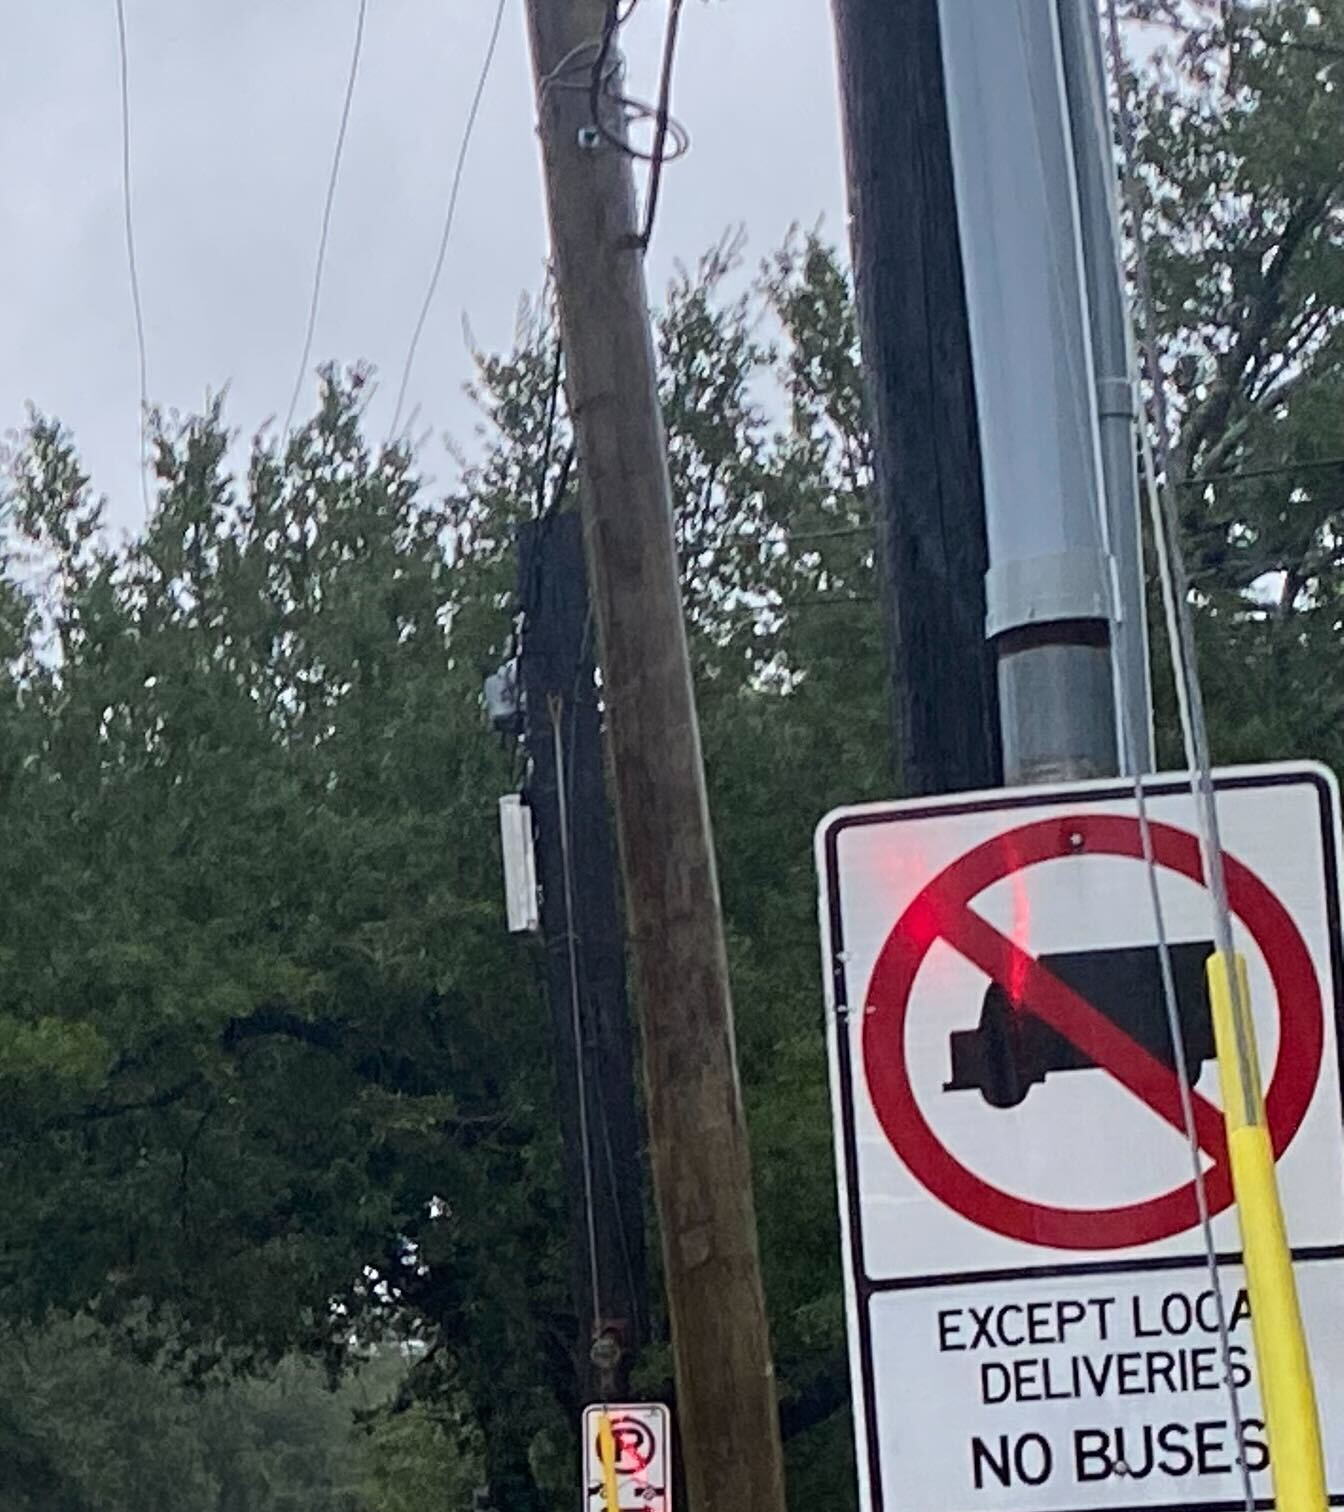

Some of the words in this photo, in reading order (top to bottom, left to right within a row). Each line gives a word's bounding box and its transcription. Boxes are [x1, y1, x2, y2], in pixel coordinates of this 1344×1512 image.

[937, 1297, 1115, 1352] EXCEPT
[1132, 1288, 1252, 1338] LOCA
[980, 1345, 1252, 1405] DELIVERIES
[971, 1432, 1053, 1489] NO
[1073, 1418, 1271, 1483] BUSES
